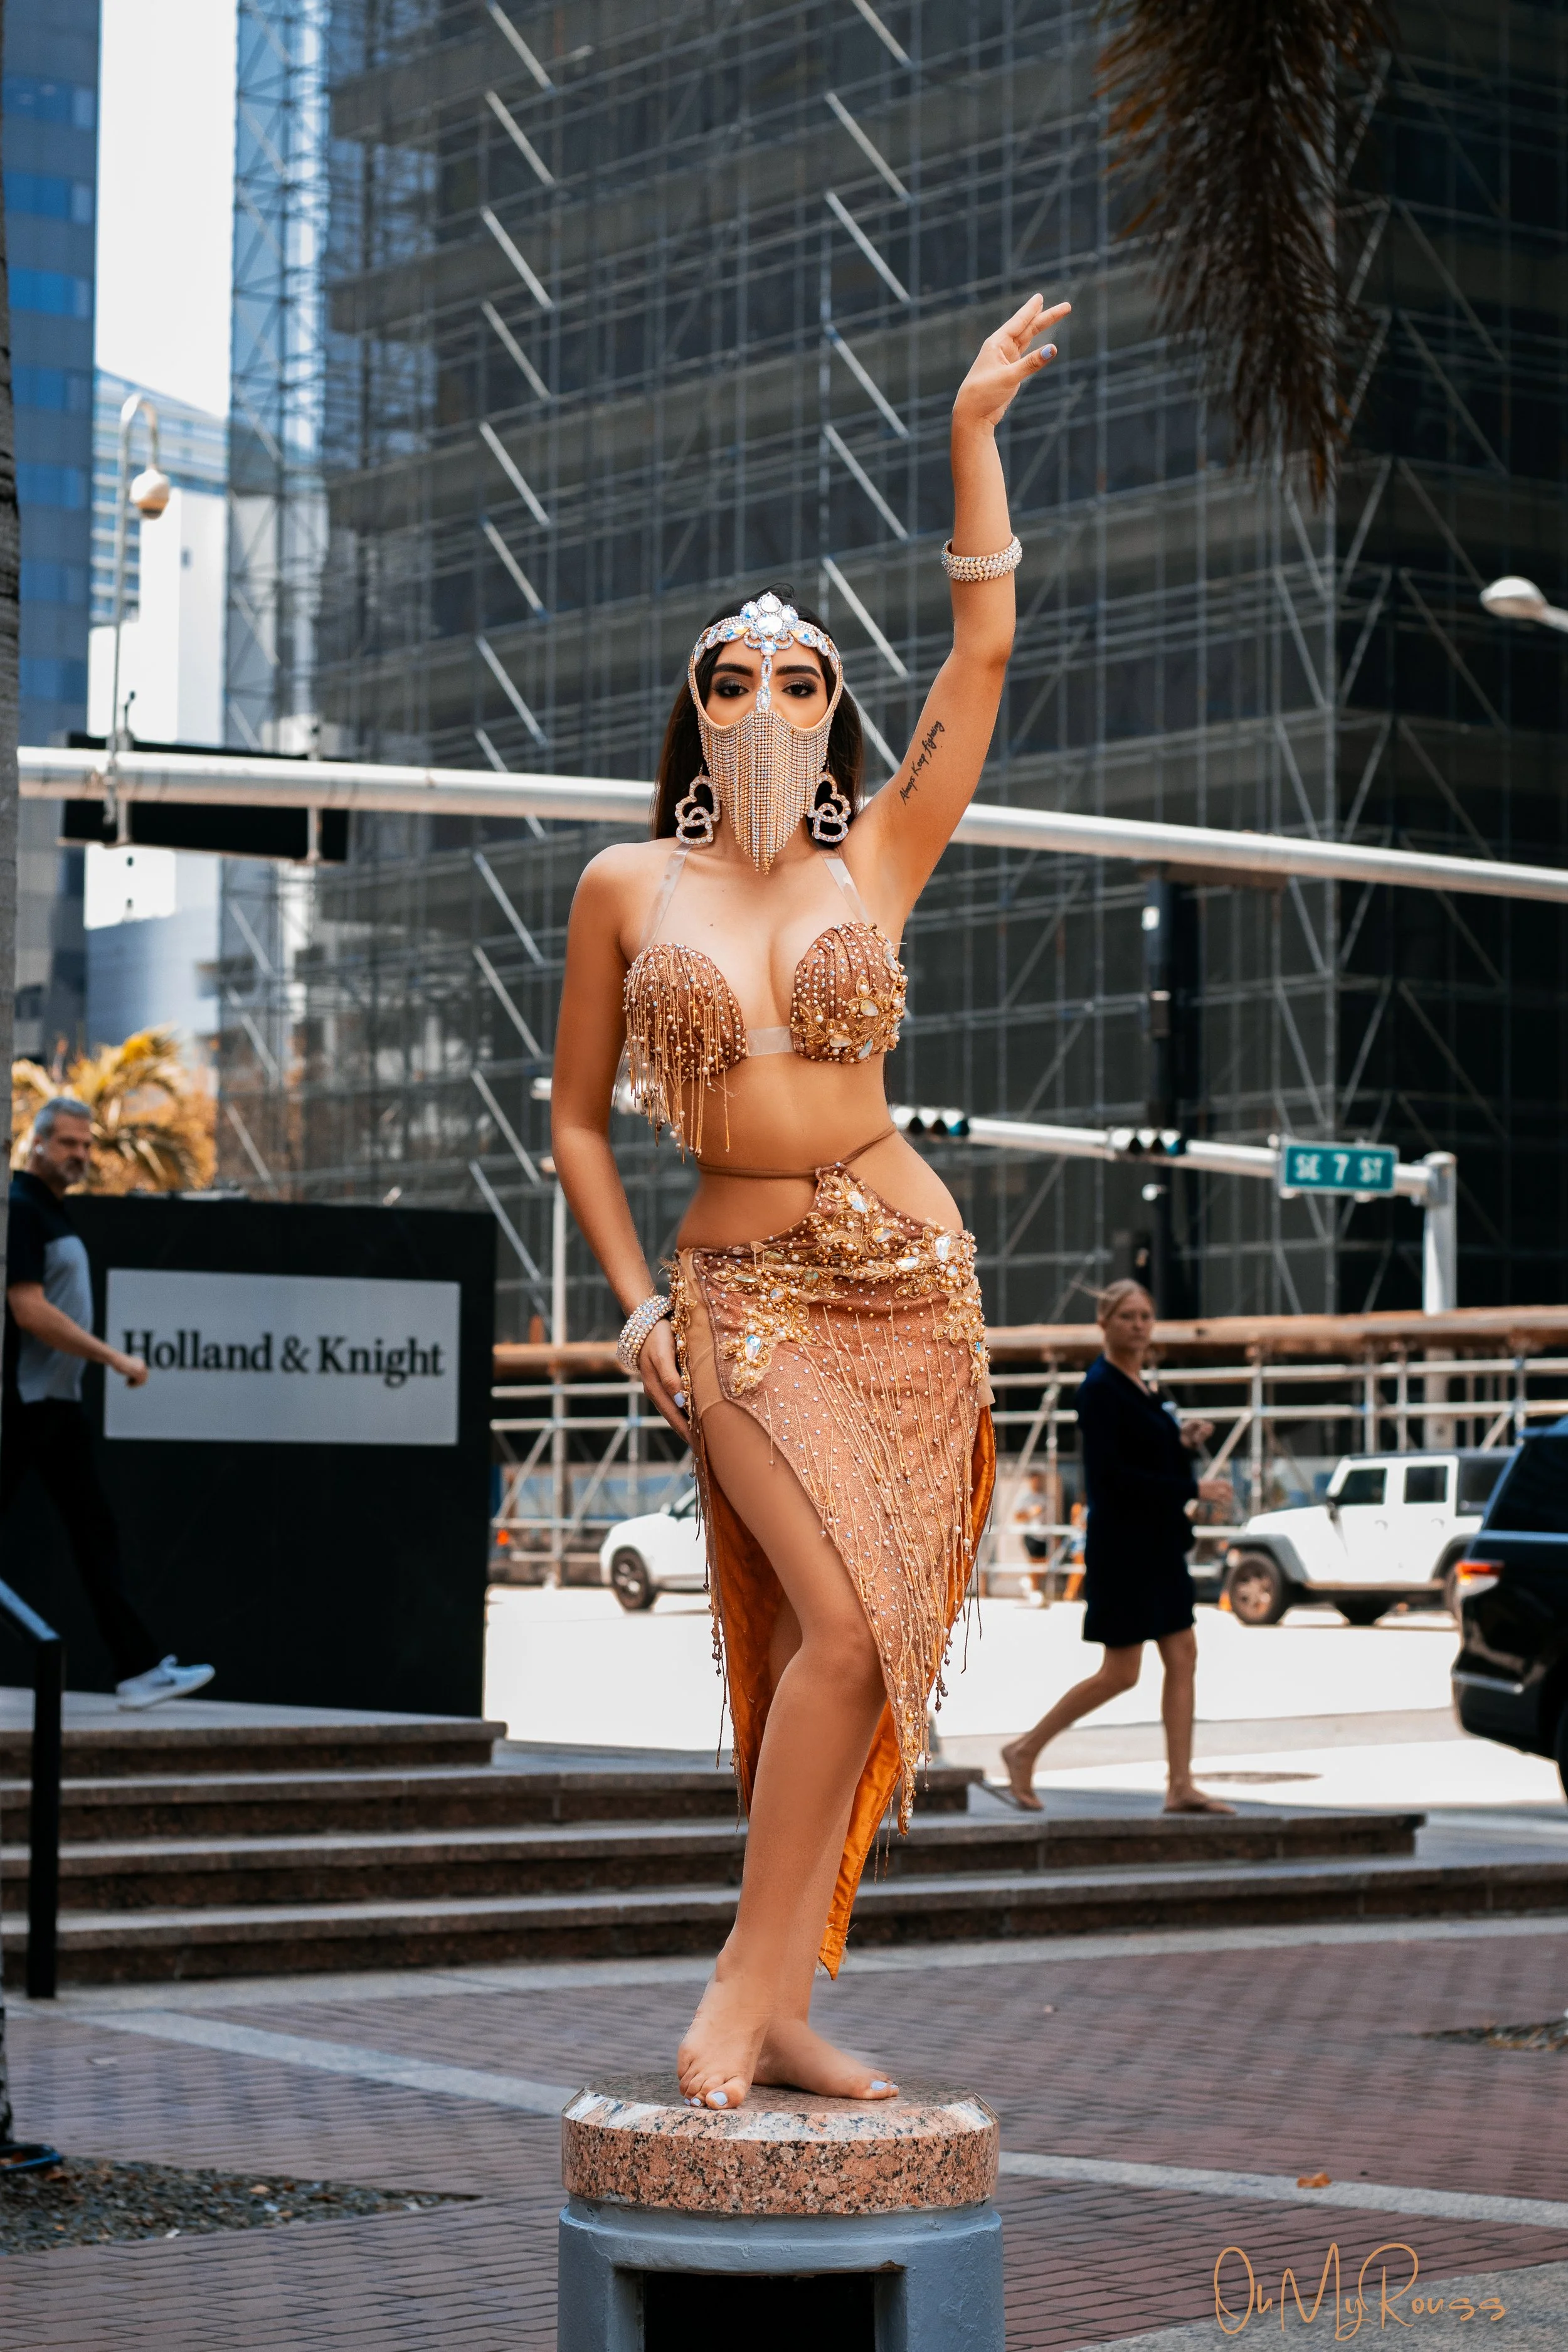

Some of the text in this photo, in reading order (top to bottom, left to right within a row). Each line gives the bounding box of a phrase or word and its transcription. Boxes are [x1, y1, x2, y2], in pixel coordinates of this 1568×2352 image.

[899, 775, 918, 805] Always
[911, 753, 930, 776] Keep
[1333, 1153, 1349, 1183] 7
[123, 1329, 445, 1389] Holland & Knight
